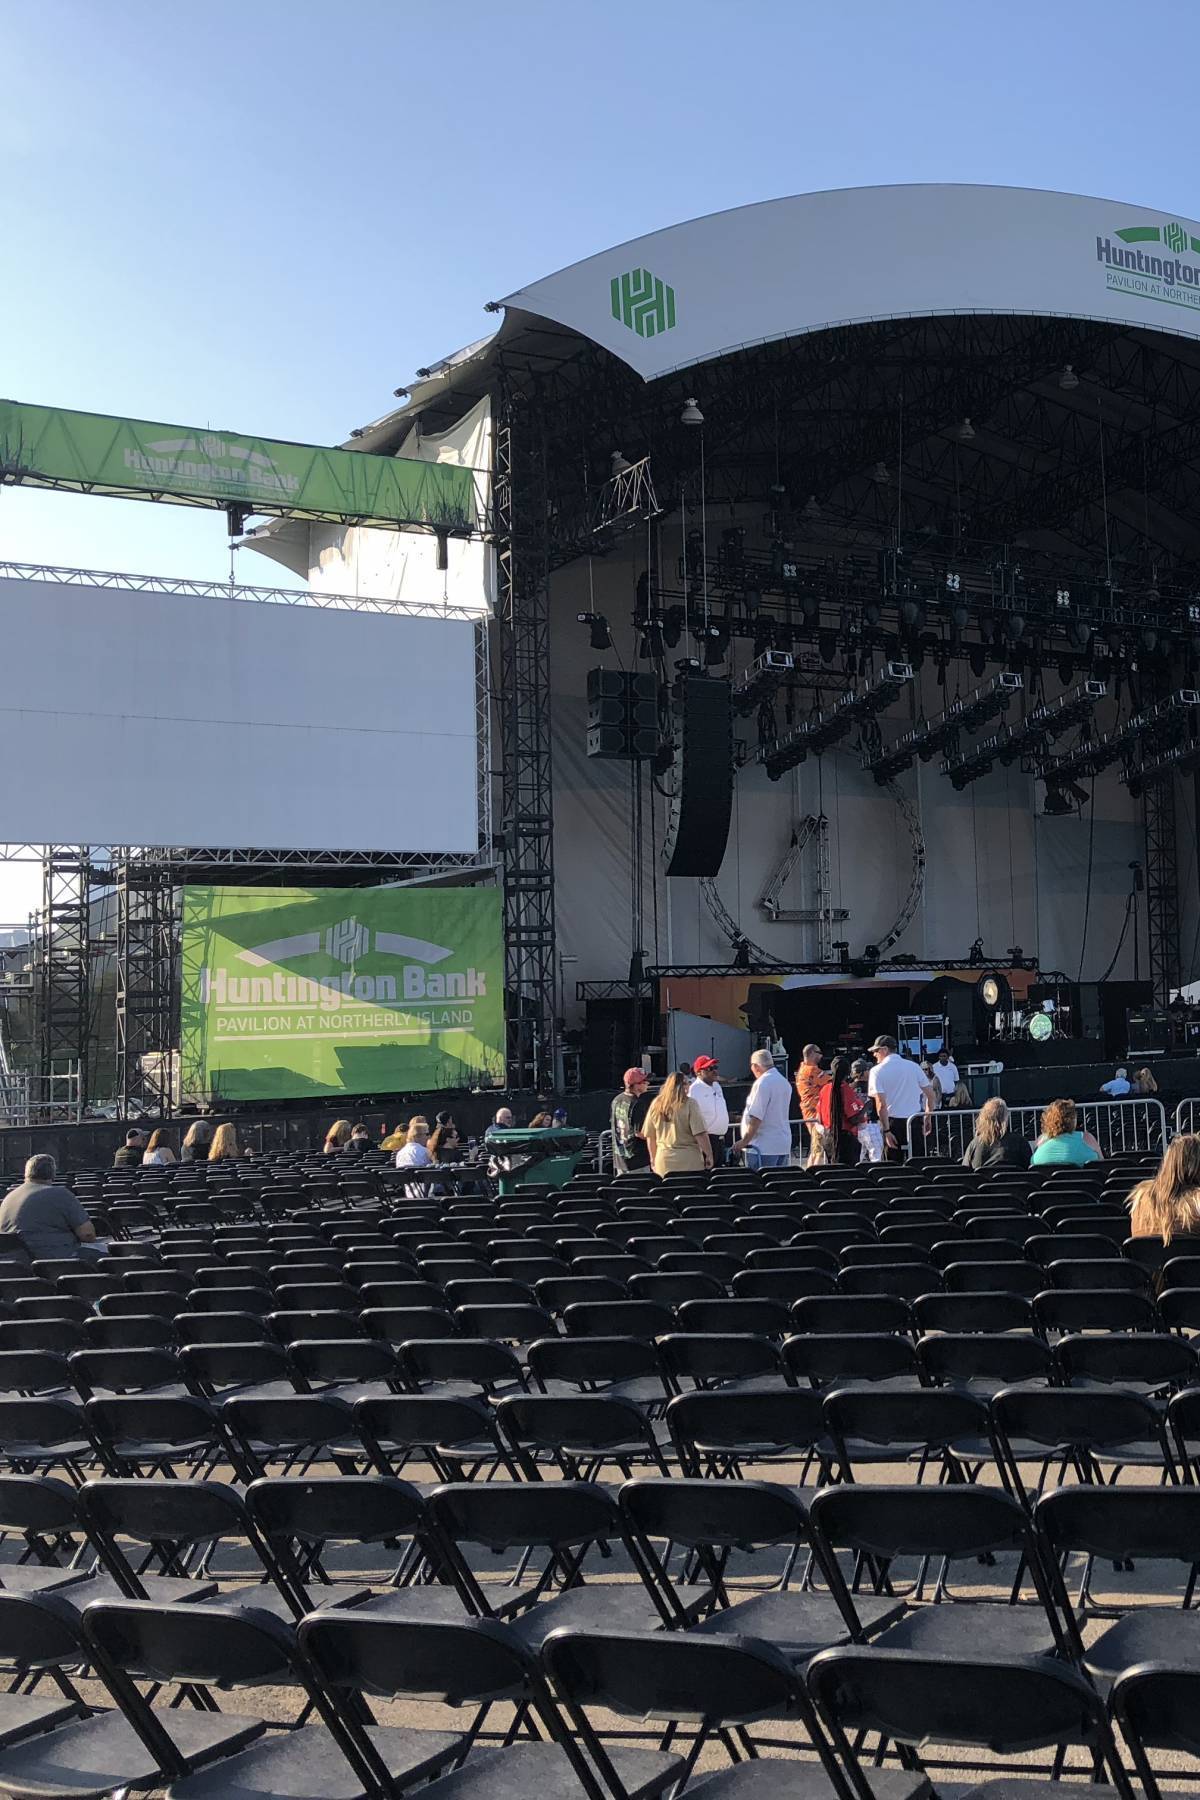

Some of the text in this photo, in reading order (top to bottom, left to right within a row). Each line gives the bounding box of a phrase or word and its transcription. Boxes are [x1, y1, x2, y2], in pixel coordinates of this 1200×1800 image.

[1106, 272, 1148, 292] PAVILION
[1150, 284, 1161, 294] AT
[249, 465, 300, 490] Bank
[200, 965, 487, 1012] Huntington Bank
[216, 1009, 473, 1032] PAVILION AT NORTHERLY ISLAND
